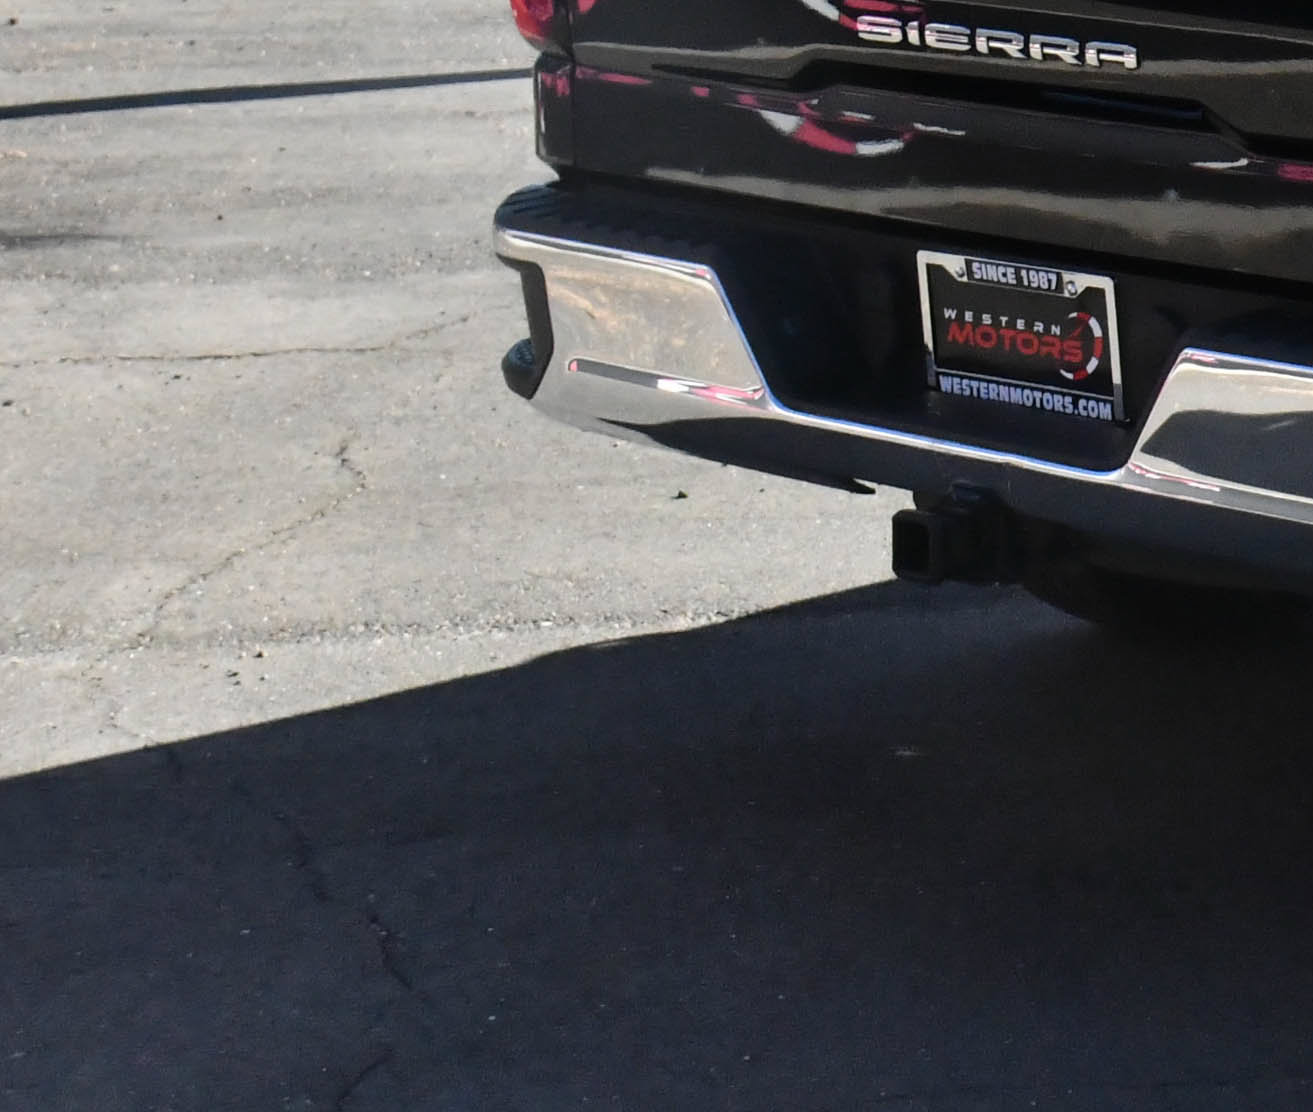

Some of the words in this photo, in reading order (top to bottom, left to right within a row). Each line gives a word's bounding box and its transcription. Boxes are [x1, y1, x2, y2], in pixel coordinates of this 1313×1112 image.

[856, 14, 1142, 72] SIERRA
[972, 261, 1017, 285] SINCE
[1020, 269, 1057, 291] 1987
[943, 307, 1061, 336] WESTERN
[947, 320, 1083, 364] MOTORS
[938, 374, 1113, 422] WESTERNMOTORS.COM
